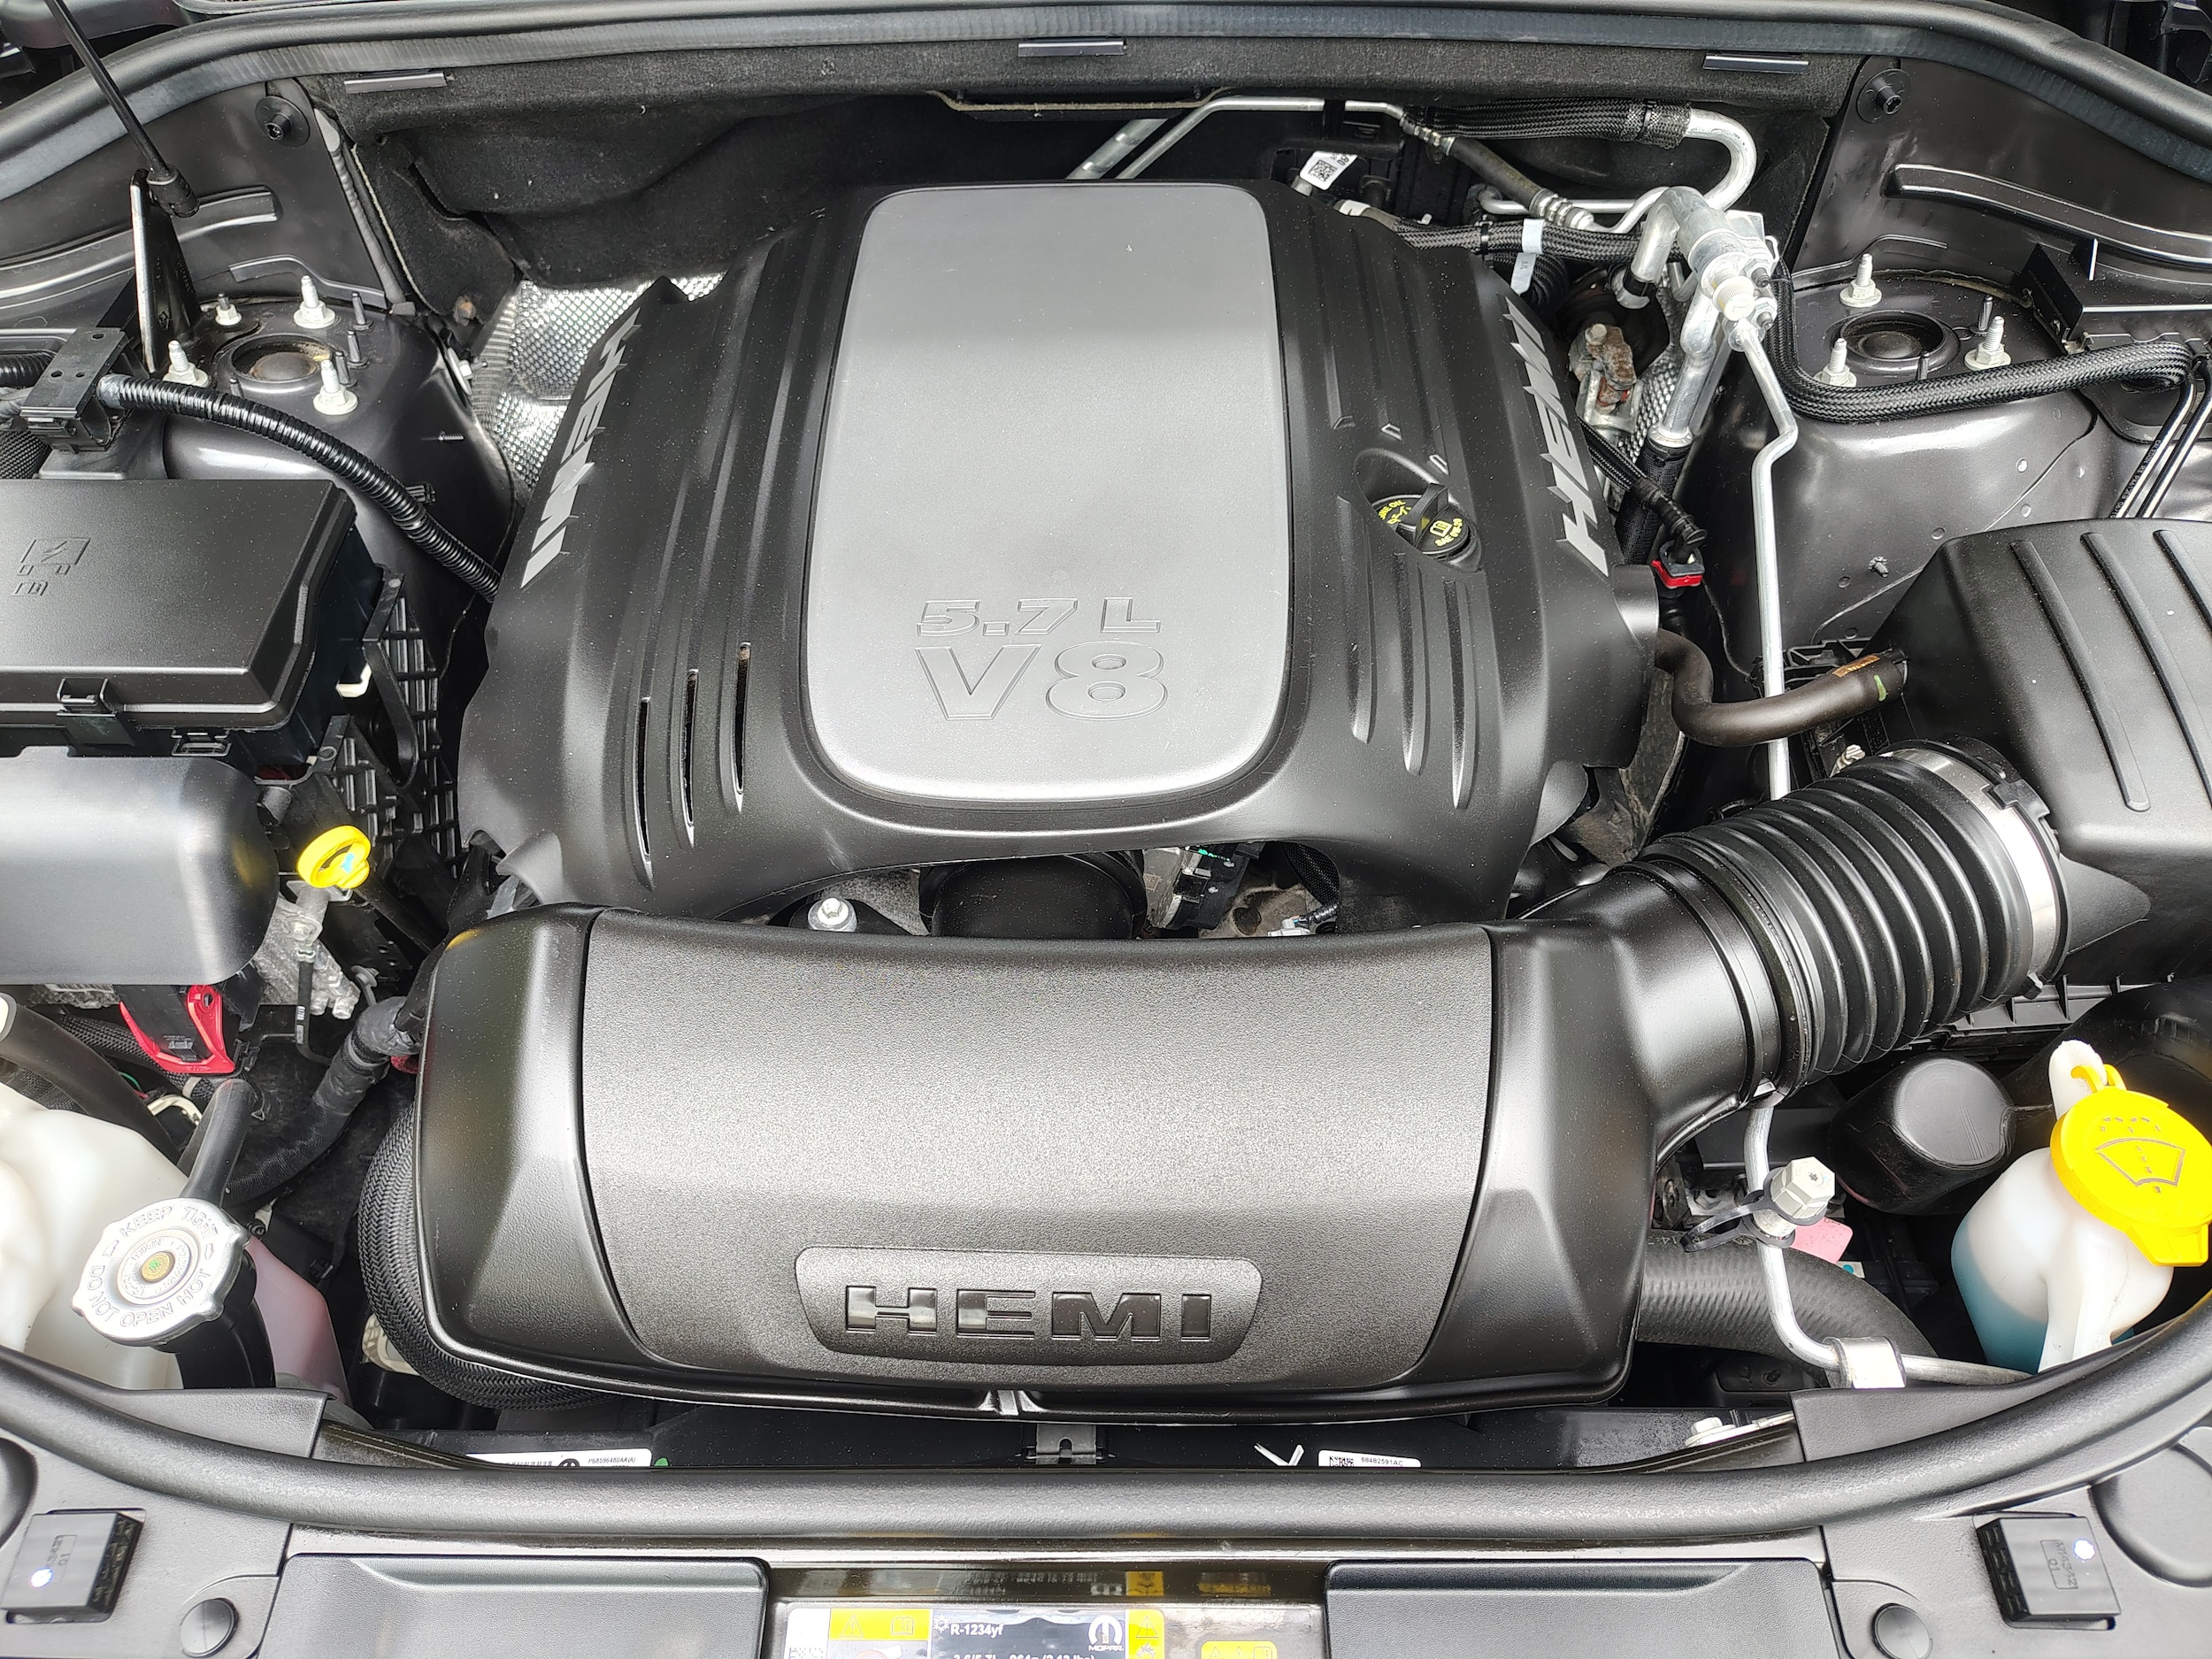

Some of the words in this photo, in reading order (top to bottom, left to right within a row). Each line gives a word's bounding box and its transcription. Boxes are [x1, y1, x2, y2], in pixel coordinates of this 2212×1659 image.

[520, 307, 641, 589] HEMI
[1502, 296, 1609, 577] HEMI
[1434, 534, 1454, 547] SAE
[916, 597, 1078, 636] 5.7
[1100, 597, 1161, 633] L
[915, 641, 1168, 721] V8
[119, 1205, 173, 1237] KEEP
[181, 1205, 219, 1239] TIGHT
[88, 1264, 106, 1290] DO
[176, 1268, 211, 1306] HOT
[89, 1291, 120, 1322] NOT
[120, 1302, 174, 1327] OPEN
[845, 1286, 1212, 1342] HEMI
[1361, 1456, 1403, 1467] 68482591AC
[950, 1623, 1004, 1639] R-1234yf
